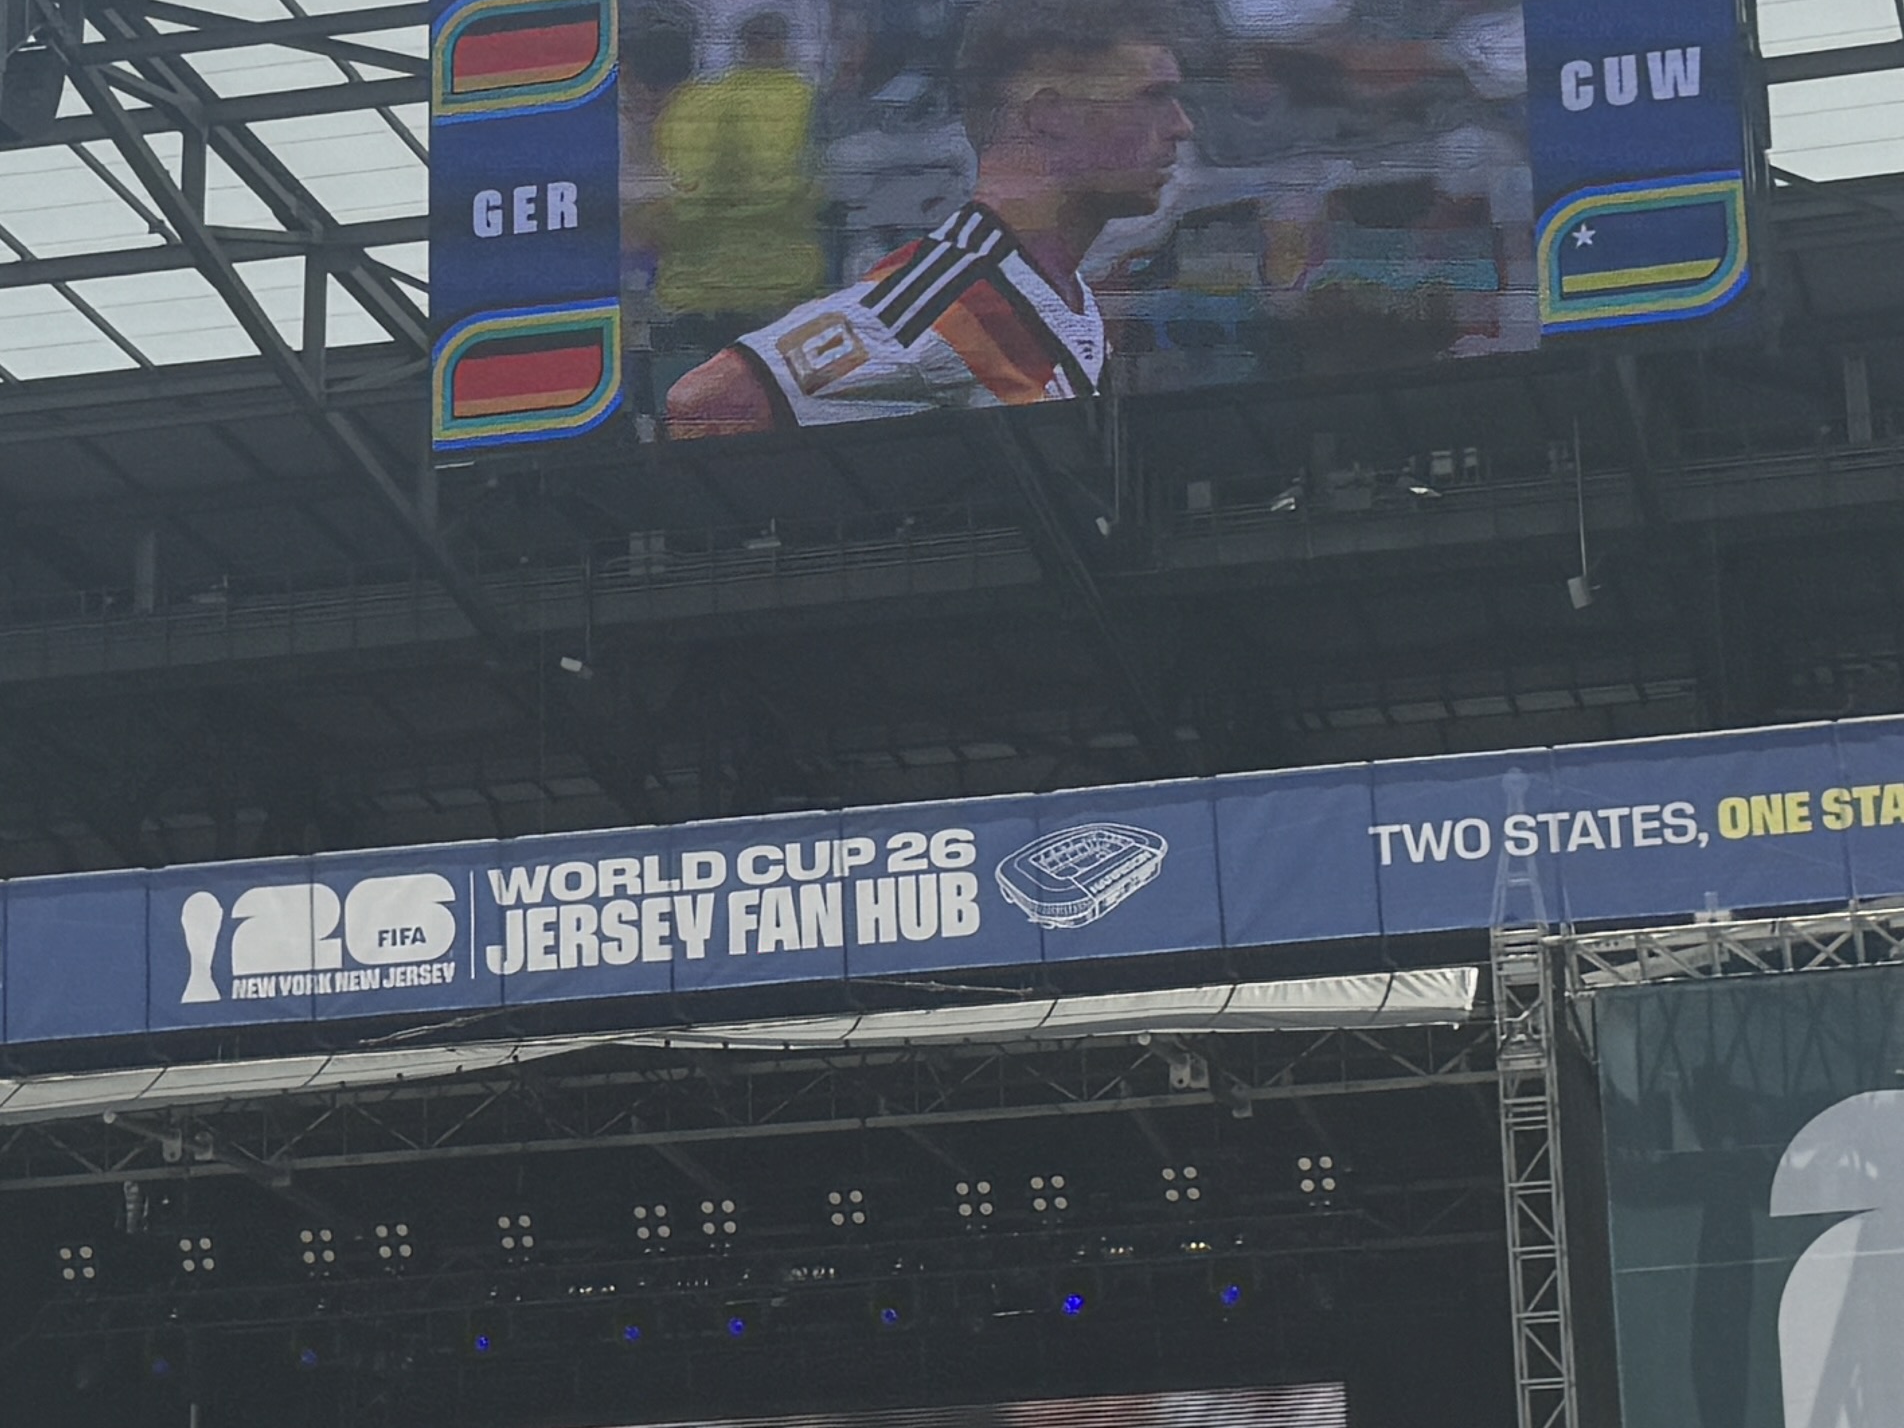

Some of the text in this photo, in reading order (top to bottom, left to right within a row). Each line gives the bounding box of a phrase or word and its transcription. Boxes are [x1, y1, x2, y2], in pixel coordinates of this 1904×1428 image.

[1560, 46, 1702, 112] CUW
[473, 180, 578, 239] GER
[1368, 816, 1491, 866] TWO
[1502, 801, 1710, 859] STATES,
[1717, 789, 1811, 841] ONE
[487, 827, 977, 905] WORLD CUP 26
[377, 926, 428, 949] FIFA
[486, 870, 982, 975] JERSEY FAN HUB
[231, 961, 457, 1000] NEW YORK NEW JERSEY
